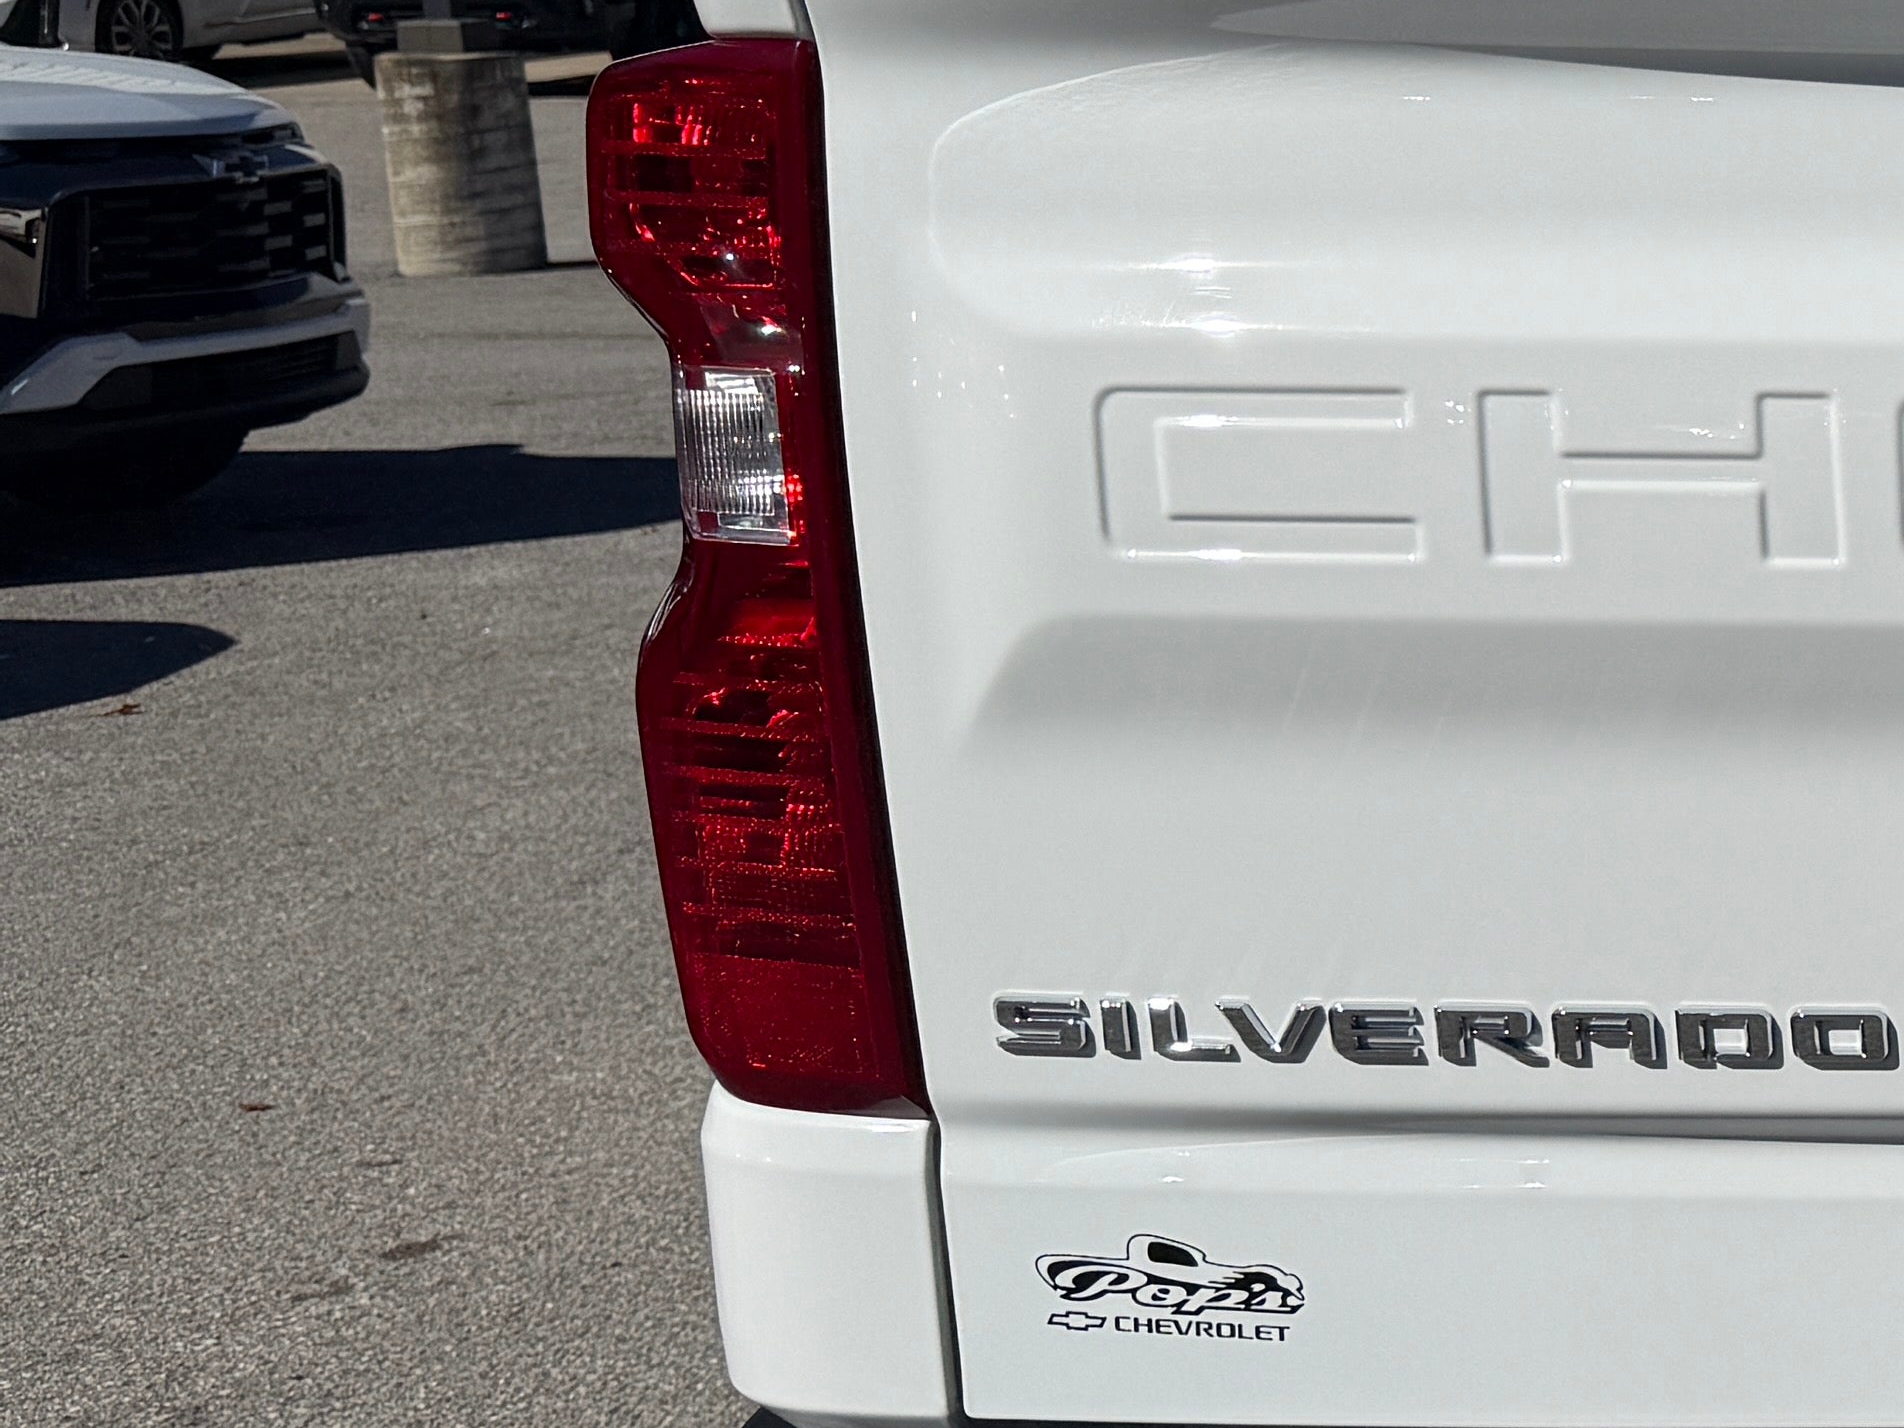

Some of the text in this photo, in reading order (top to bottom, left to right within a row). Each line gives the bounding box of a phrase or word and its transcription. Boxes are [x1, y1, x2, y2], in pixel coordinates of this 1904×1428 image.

[993, 992, 1898, 1069] SILVERADO
[1052, 1263, 1297, 1315] Pop's
[1113, 1315, 1291, 1342] CHEVROLET
